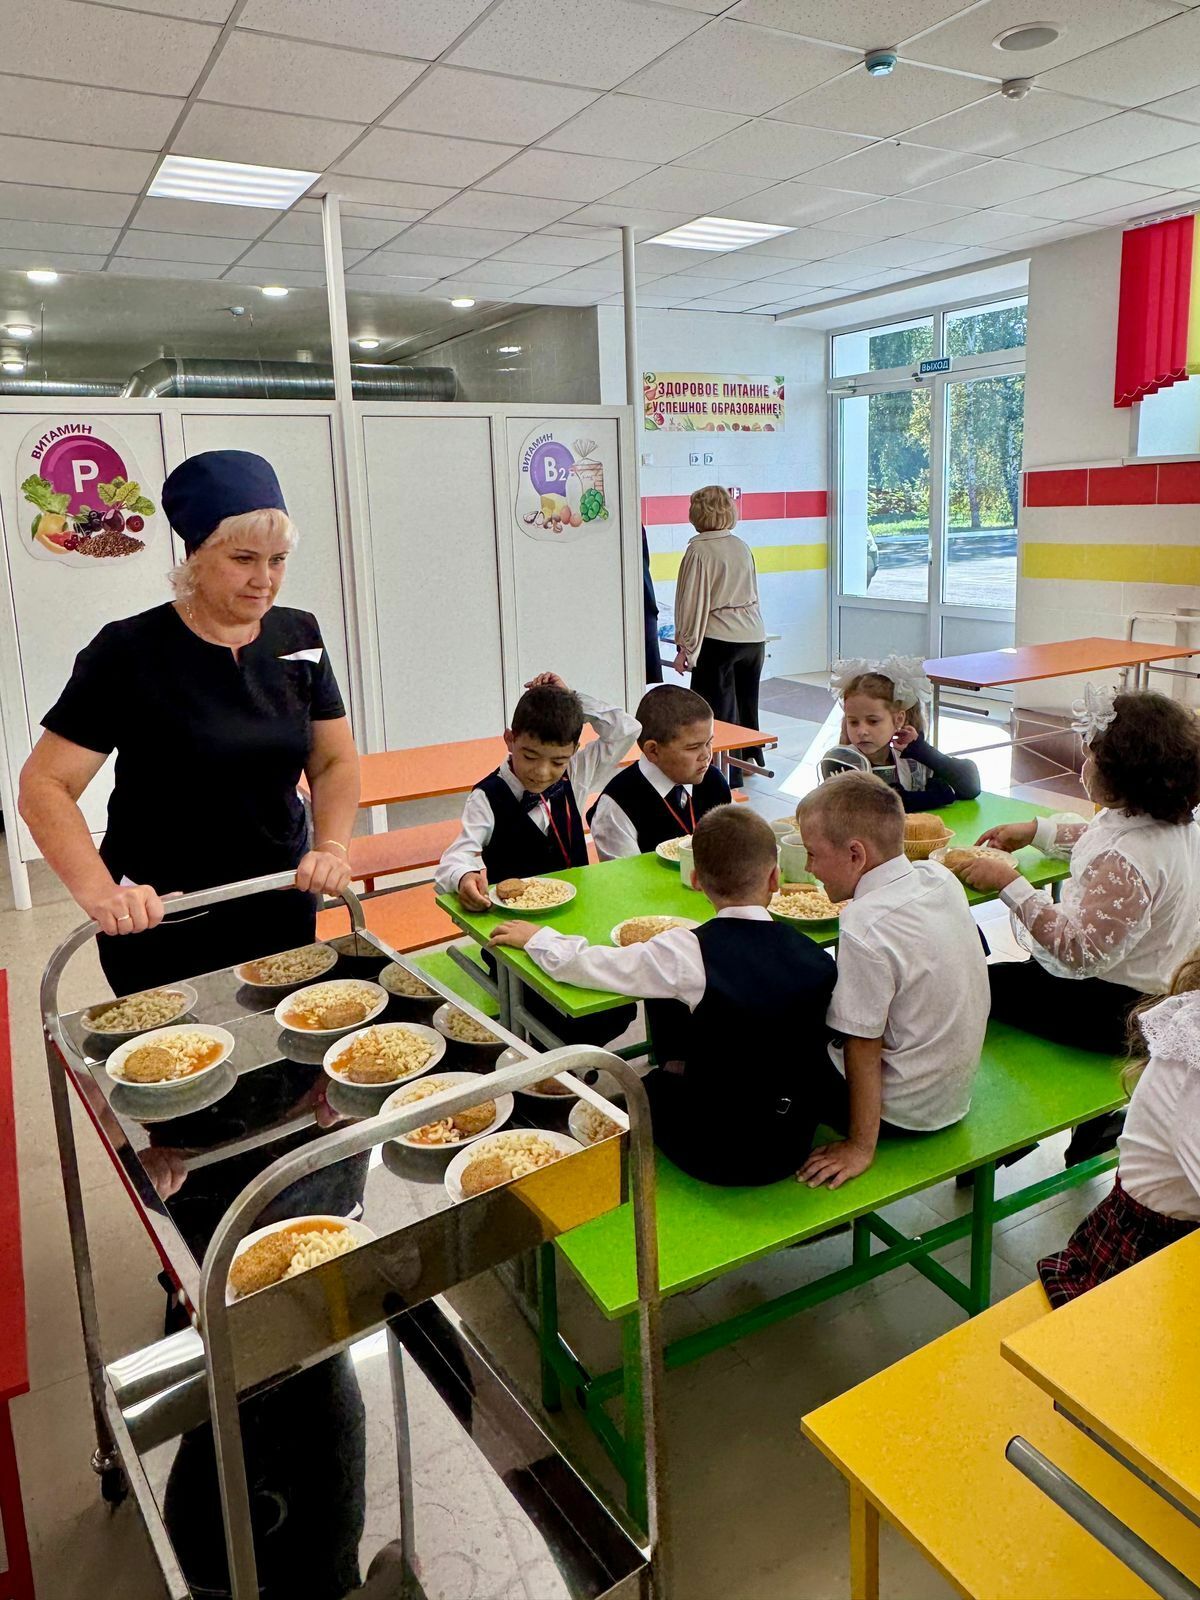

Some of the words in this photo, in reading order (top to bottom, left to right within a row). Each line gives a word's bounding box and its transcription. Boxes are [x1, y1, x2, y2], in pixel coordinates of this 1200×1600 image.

[921, 360, 949, 372] ВЫХОД
[658, 382, 719, 396] ЗДОРОВОЕ
[722, 383, 769, 397] ПИТАНИЕ
[652, 401, 708, 414] УСПЕШНОЕ
[711, 402, 782, 415] ОБРАЗОВАНИЕ!
[31, 423, 92, 460] ВИТАМИН
[522, 433, 553, 472] ВИТАМИН
